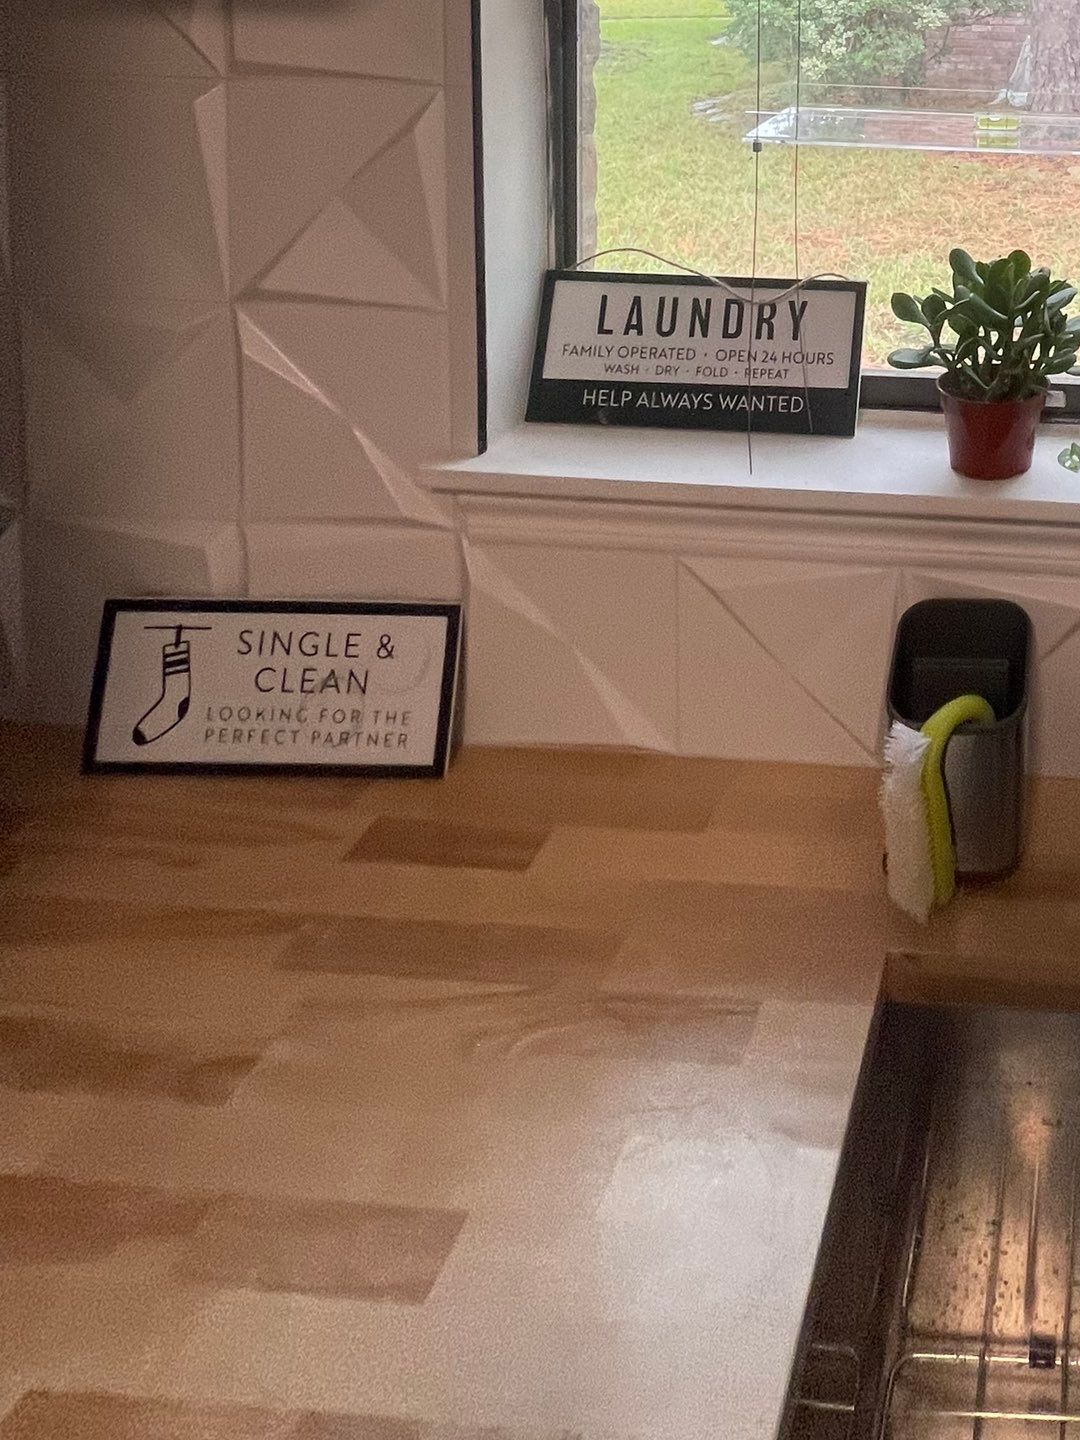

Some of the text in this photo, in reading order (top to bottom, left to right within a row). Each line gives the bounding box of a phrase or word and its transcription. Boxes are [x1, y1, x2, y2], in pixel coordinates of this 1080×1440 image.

[596, 294, 809, 342] LAUNDRY
[562, 343, 834, 366] FAMILY OPERATED OPEN 24 HOURS
[604, 363, 789, 380] WASH DRY FOLD REPEAT
[582, 389, 805, 414] HELP ALWAYS WANTED
[237, 630, 396, 660] SINGLE &
[254, 667, 369, 695] CLEAN
[206, 706, 412, 727] LOOKING FOR THE
[204, 726, 410, 749] PERFECT PARTNER
